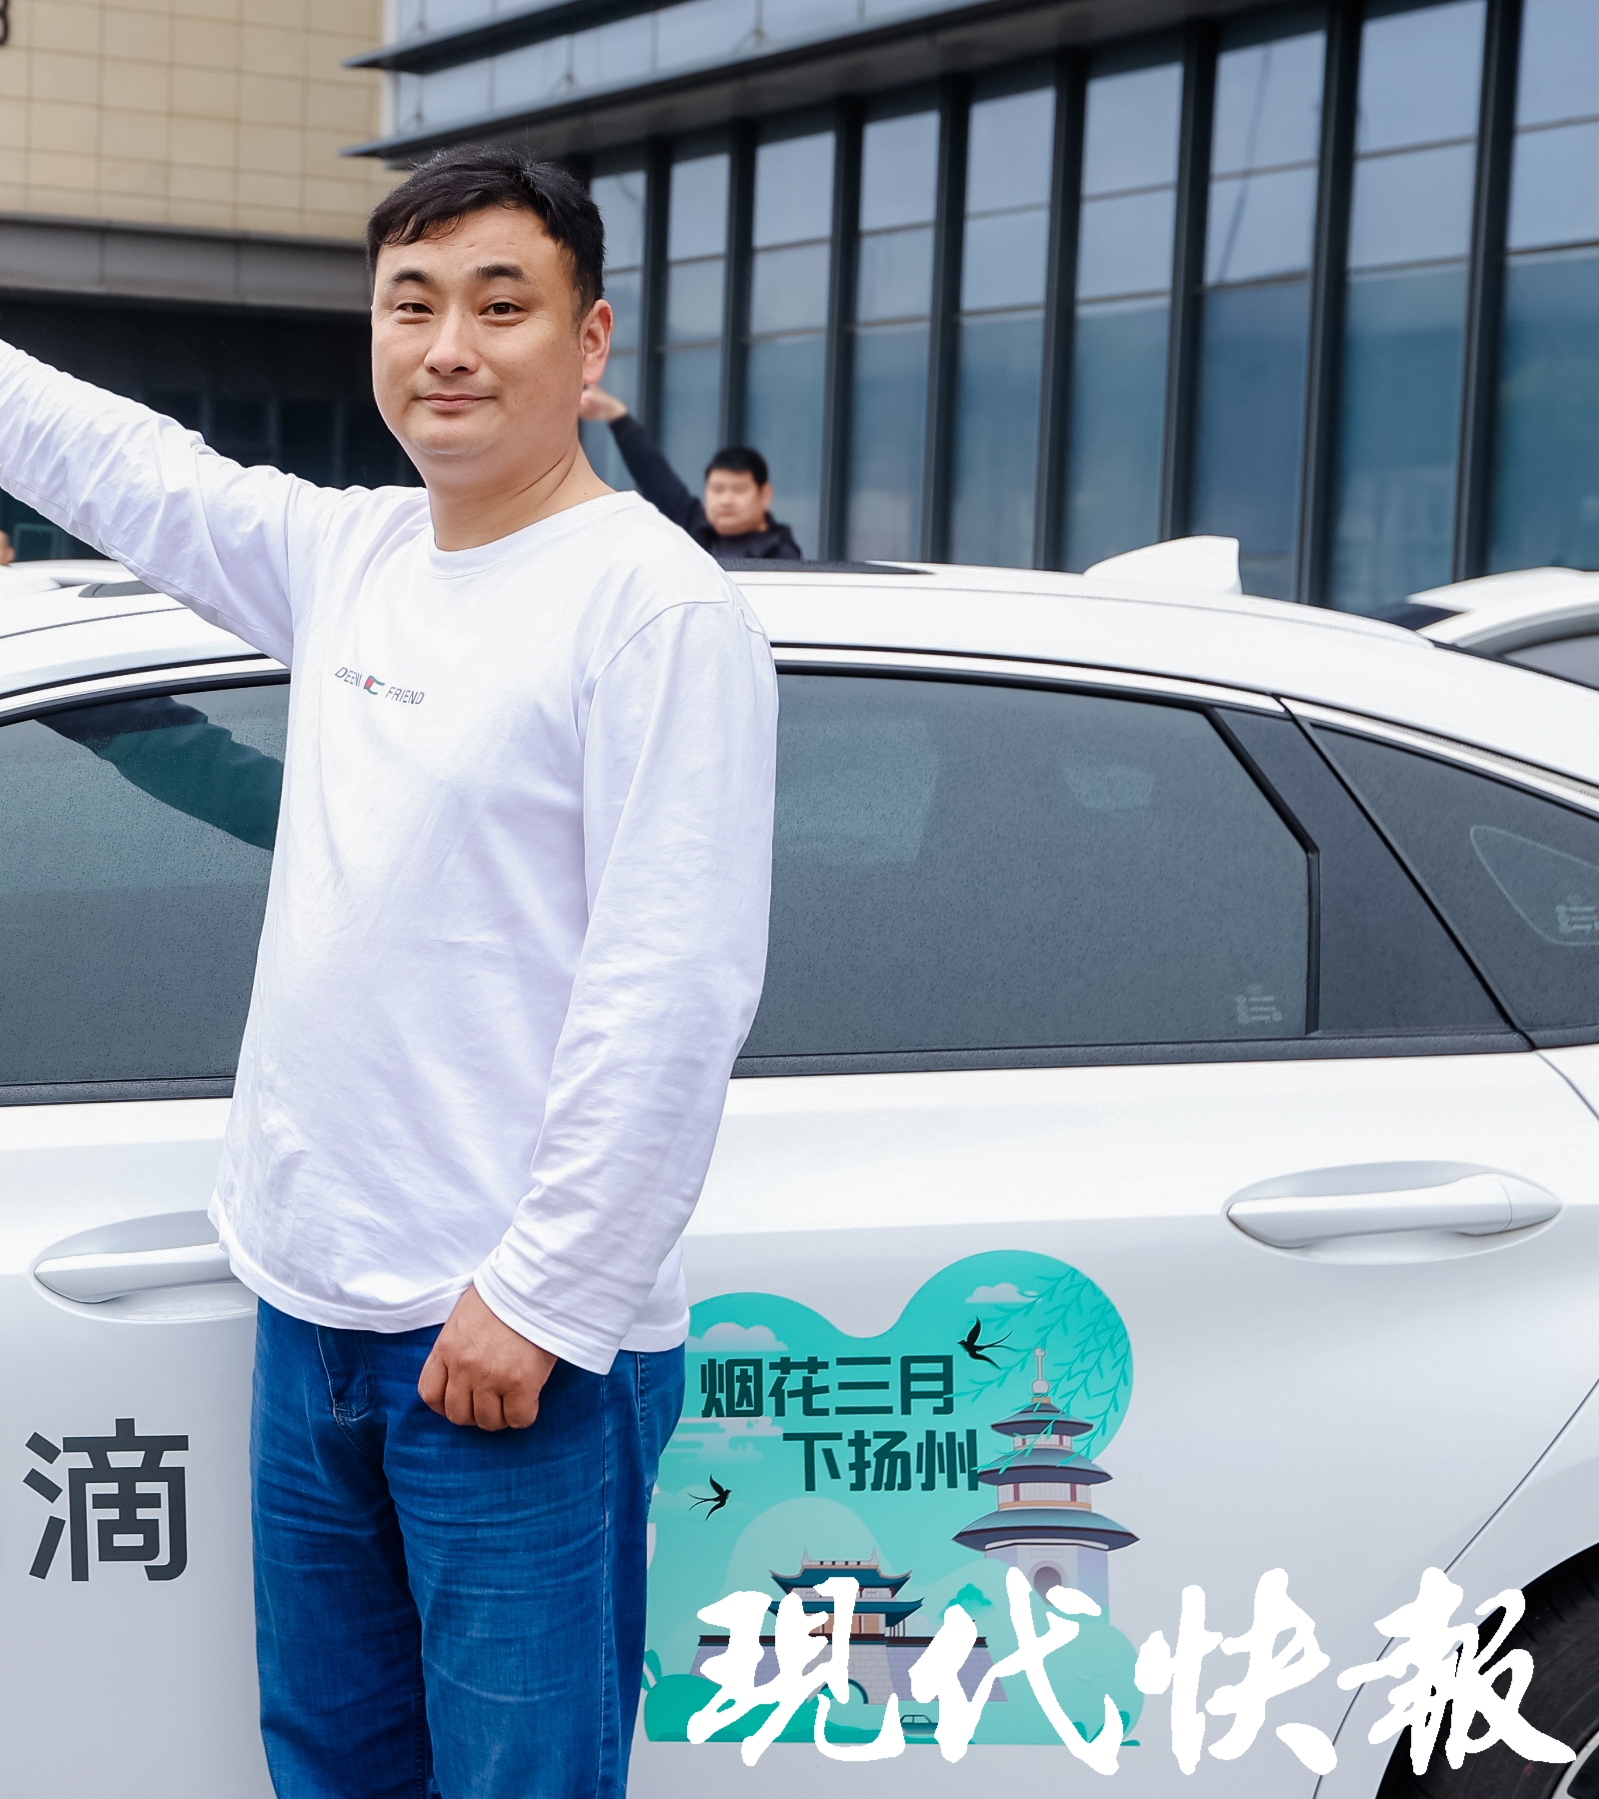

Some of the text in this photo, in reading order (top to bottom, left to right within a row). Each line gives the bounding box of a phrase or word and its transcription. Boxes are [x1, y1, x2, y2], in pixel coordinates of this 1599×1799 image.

[385, 686, 425, 705] FRIEND
[700, 1355, 955, 1418] 烟花三月
[782, 1429, 980, 1492] 下扬州
